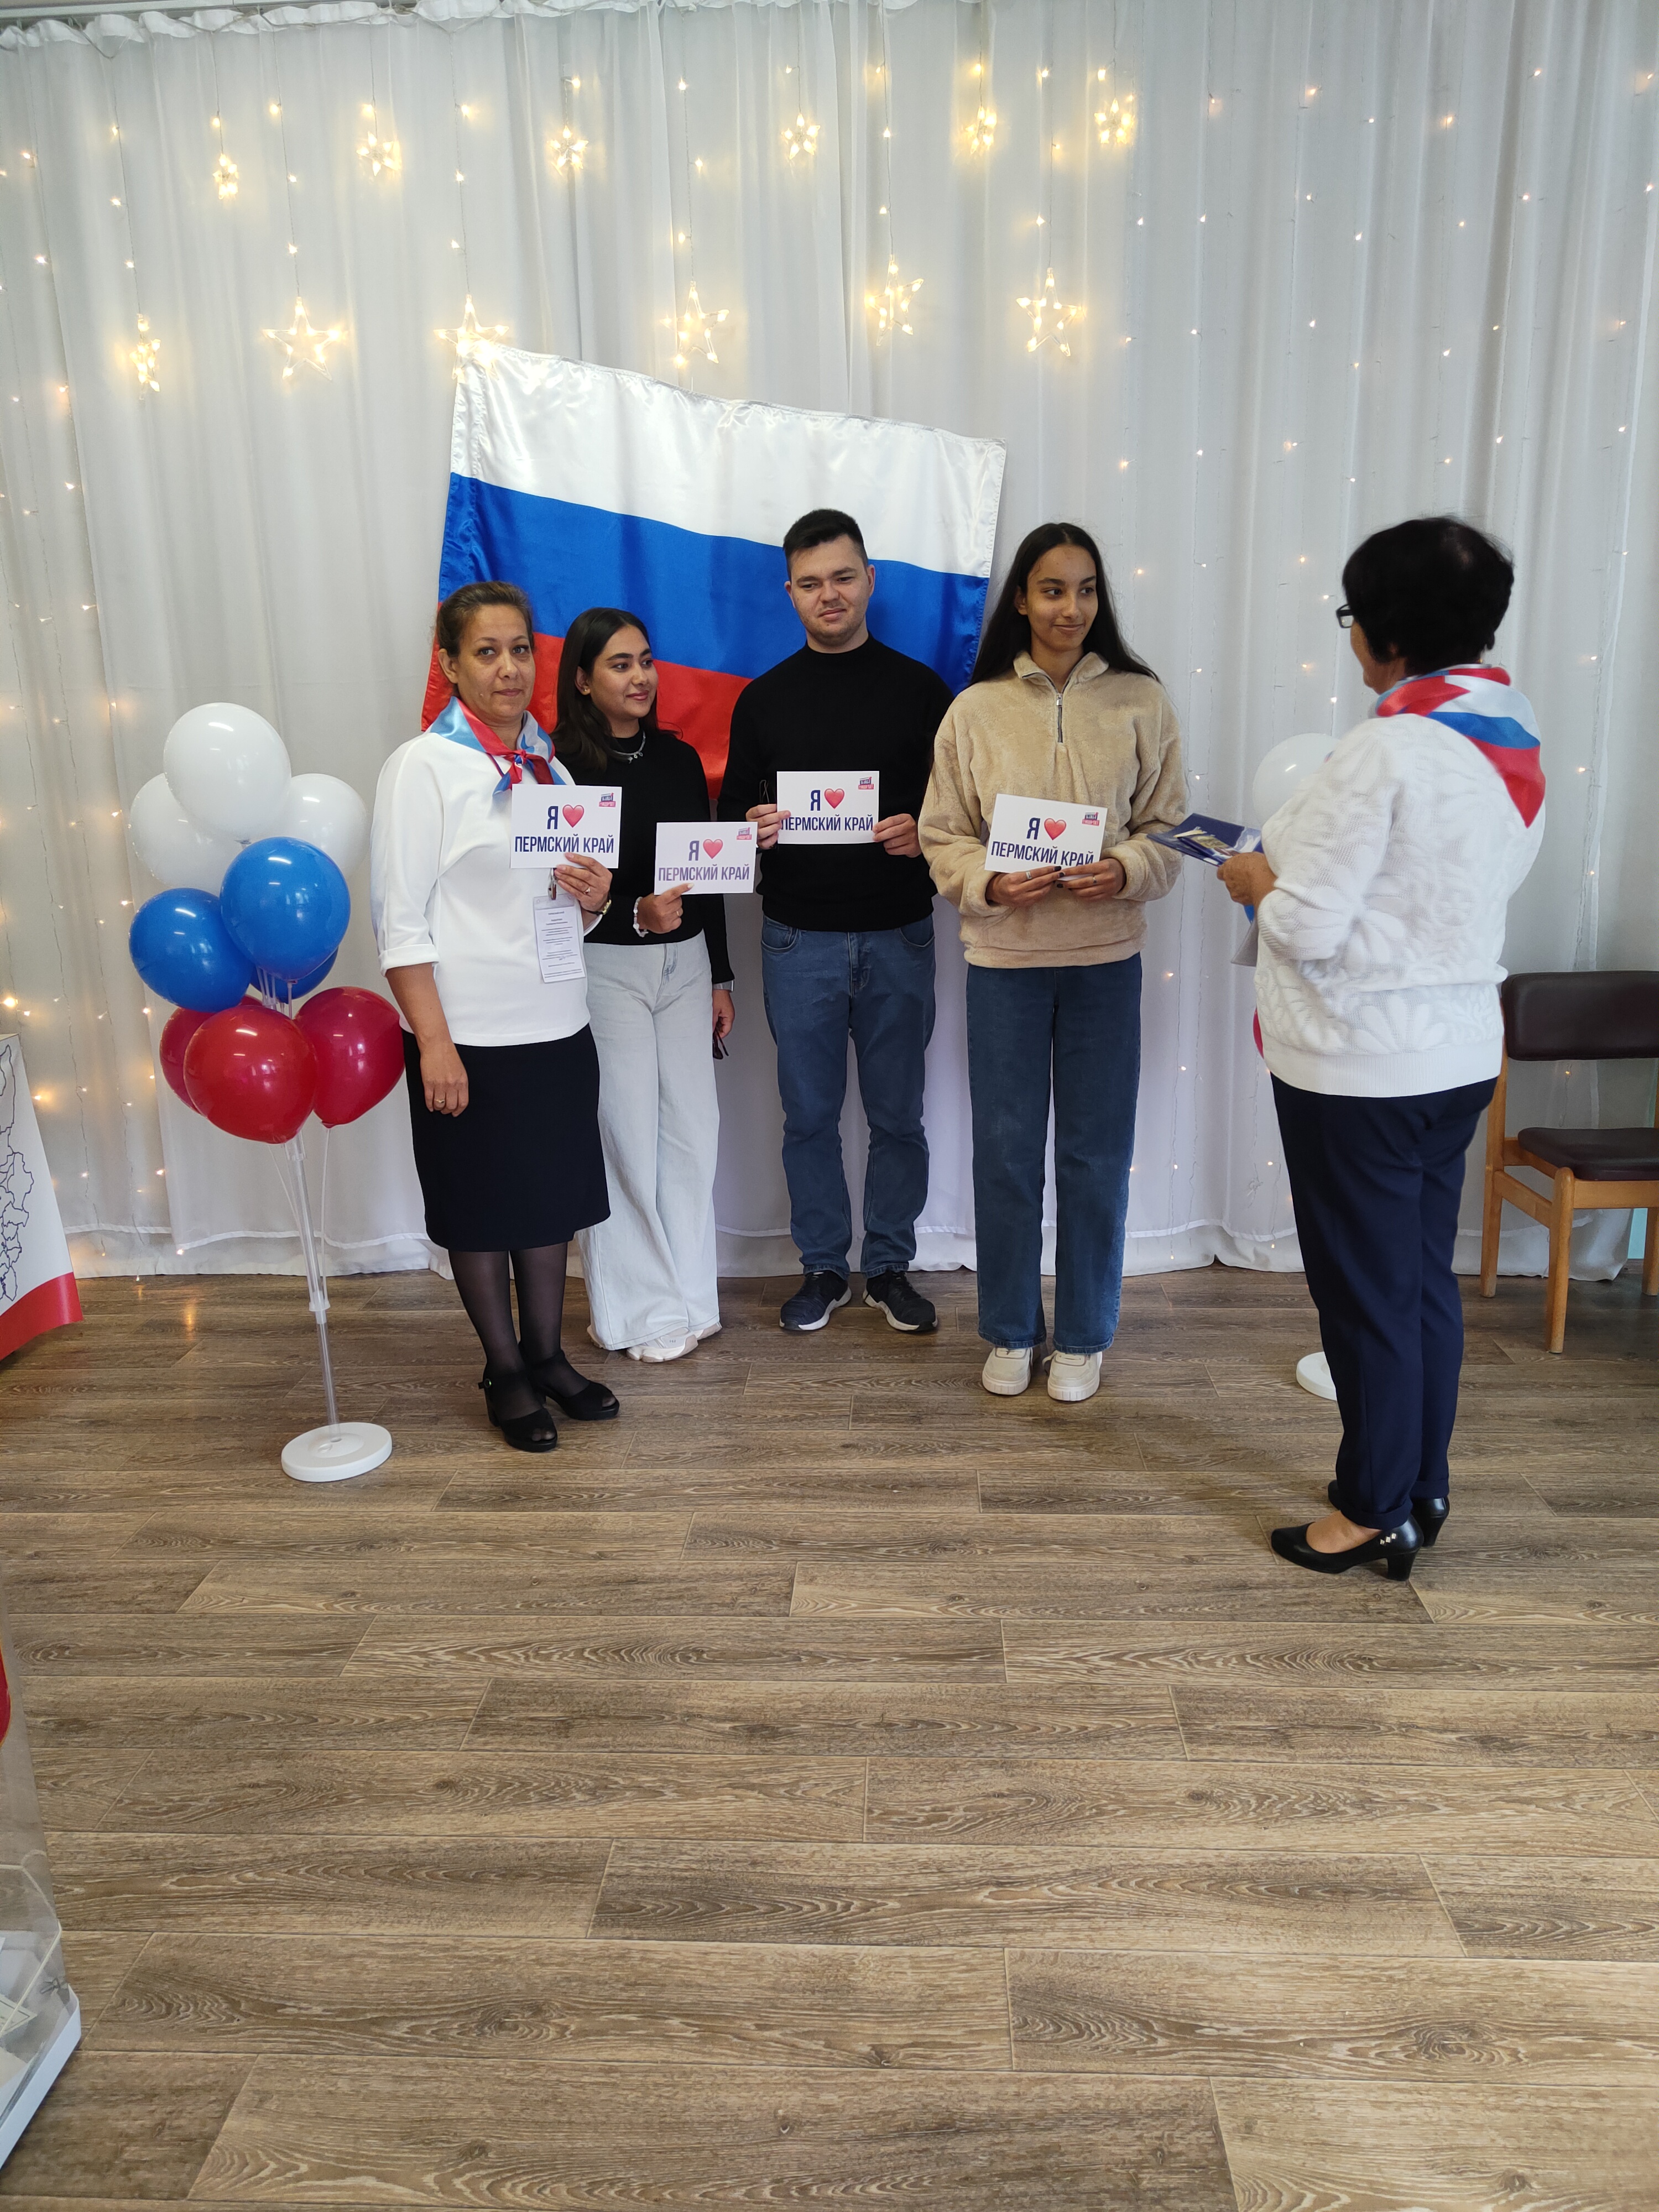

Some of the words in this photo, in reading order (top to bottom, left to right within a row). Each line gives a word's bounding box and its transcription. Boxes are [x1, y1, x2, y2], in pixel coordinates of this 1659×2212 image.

[810, 790, 821, 811] Я
[547, 806, 559, 830] Я
[781, 814, 841, 831] ПЕРМСКИЙ
[844, 814, 873, 831] КРАЙ
[1026, 817, 1041, 839] Я
[515, 833, 579, 853] ПЕРМСКИЙ
[583, 834, 614, 853] КРАЙ
[688, 841, 700, 861] Я
[991, 841, 1058, 864] ПЕРМСКИЙ
[1061, 851, 1094, 866] КРАЙ
[659, 864, 718, 881] ПЕРМСКИЙ
[721, 864, 749, 880] КРАЙ
